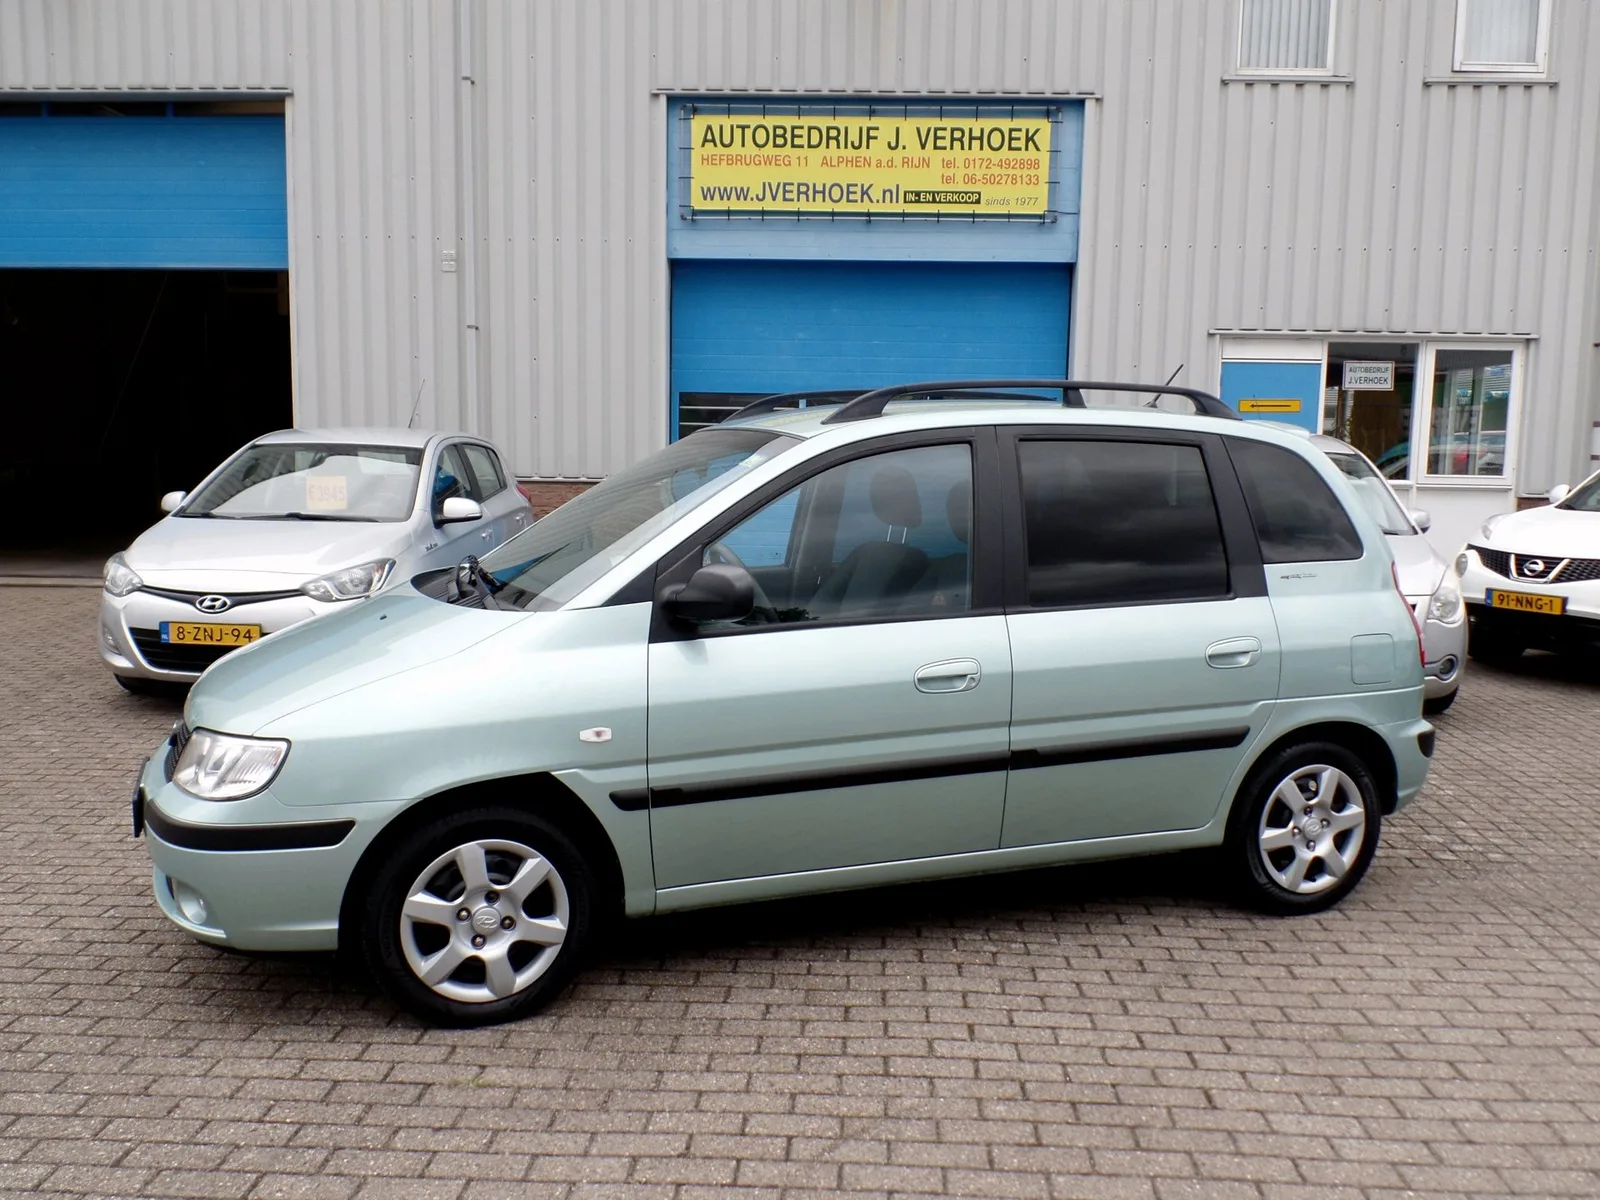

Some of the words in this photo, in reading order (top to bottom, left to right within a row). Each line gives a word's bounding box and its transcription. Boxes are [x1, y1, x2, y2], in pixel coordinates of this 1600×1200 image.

[700, 123, 880, 150] AUTOBEDRIJF
[887, 126, 907, 151] J.
[916, 126, 1042, 152] VERHOEK
[700, 153, 792, 167] HEFBRUGWEG
[796, 155, 809, 167] 11
[820, 155, 872, 168] ALPHEN
[875, 156, 898, 169] a.d.
[901, 156, 931, 169] RIJN
[941, 157, 960, 170] tel.
[963, 157, 1041, 170] 0172-492898
[941, 172, 959, 185] tel.
[962, 173, 1040, 186] 06-50278133
[700, 181, 900, 204] www.JVERHOEK.nl
[905, 193, 920, 202] IN-
[920, 193, 931, 202] EN
[934, 193, 980, 203] VERKOOP
[984, 196, 1011, 206] sinds
[1014, 196, 1039, 206] 1977
[1348, 366, 1390, 374] AUTOBEDRIJF
[1347, 376, 1389, 385] J.VERHOEK
[1497, 593, 1553, 612] 91-NNG-1
[176, 625, 253, 643] 8-ZNJ-94
